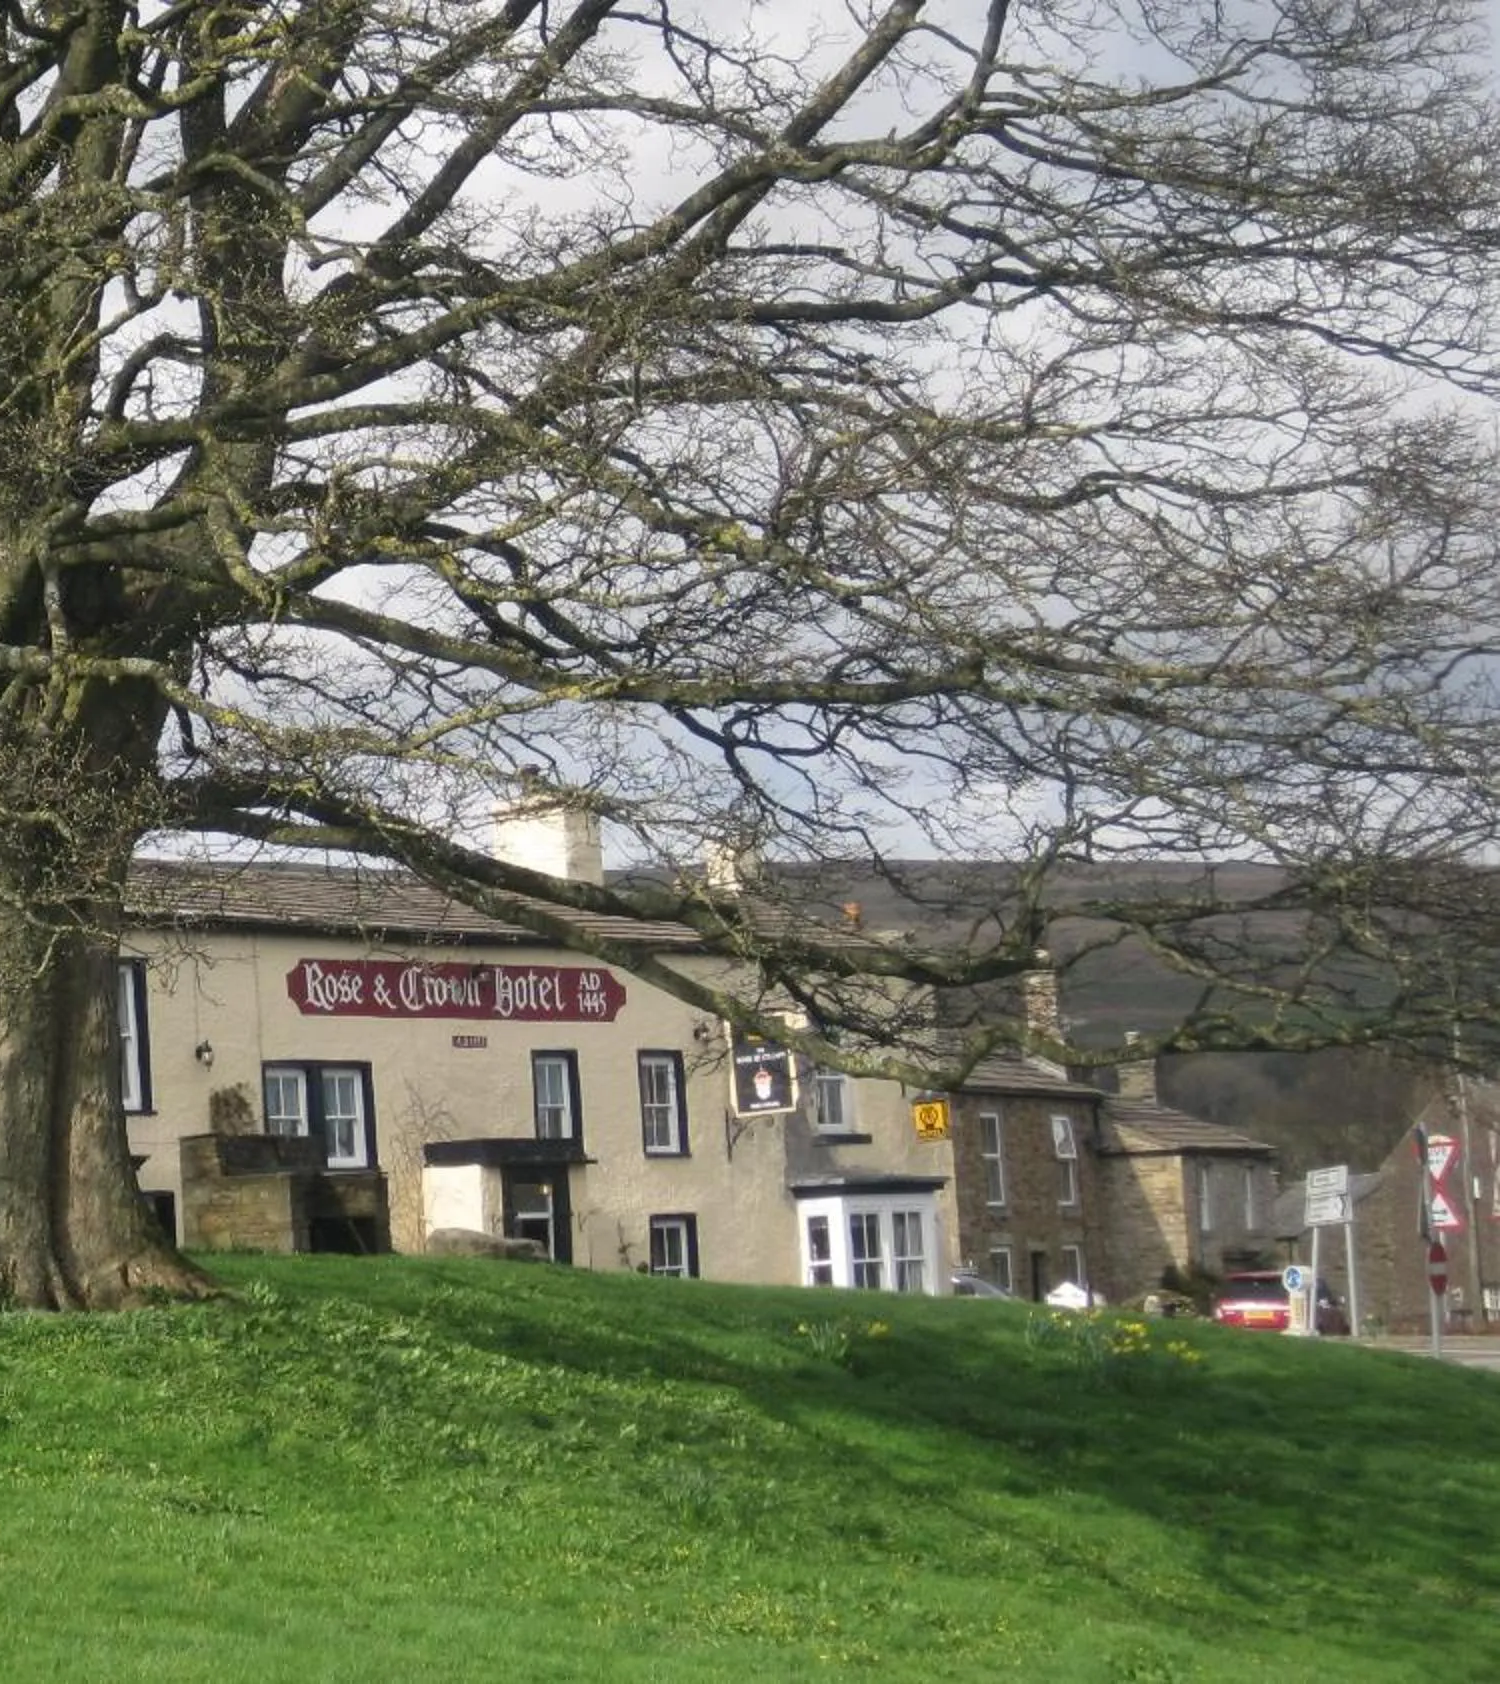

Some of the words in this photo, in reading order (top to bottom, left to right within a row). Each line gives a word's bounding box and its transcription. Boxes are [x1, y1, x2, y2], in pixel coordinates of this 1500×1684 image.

[303, 962, 364, 1011] Rose
[373, 972, 398, 1009] &
[399, 966, 482, 1012] Crown
[493, 967, 566, 1017] Hotel
[576, 991, 608, 1018] 1445
